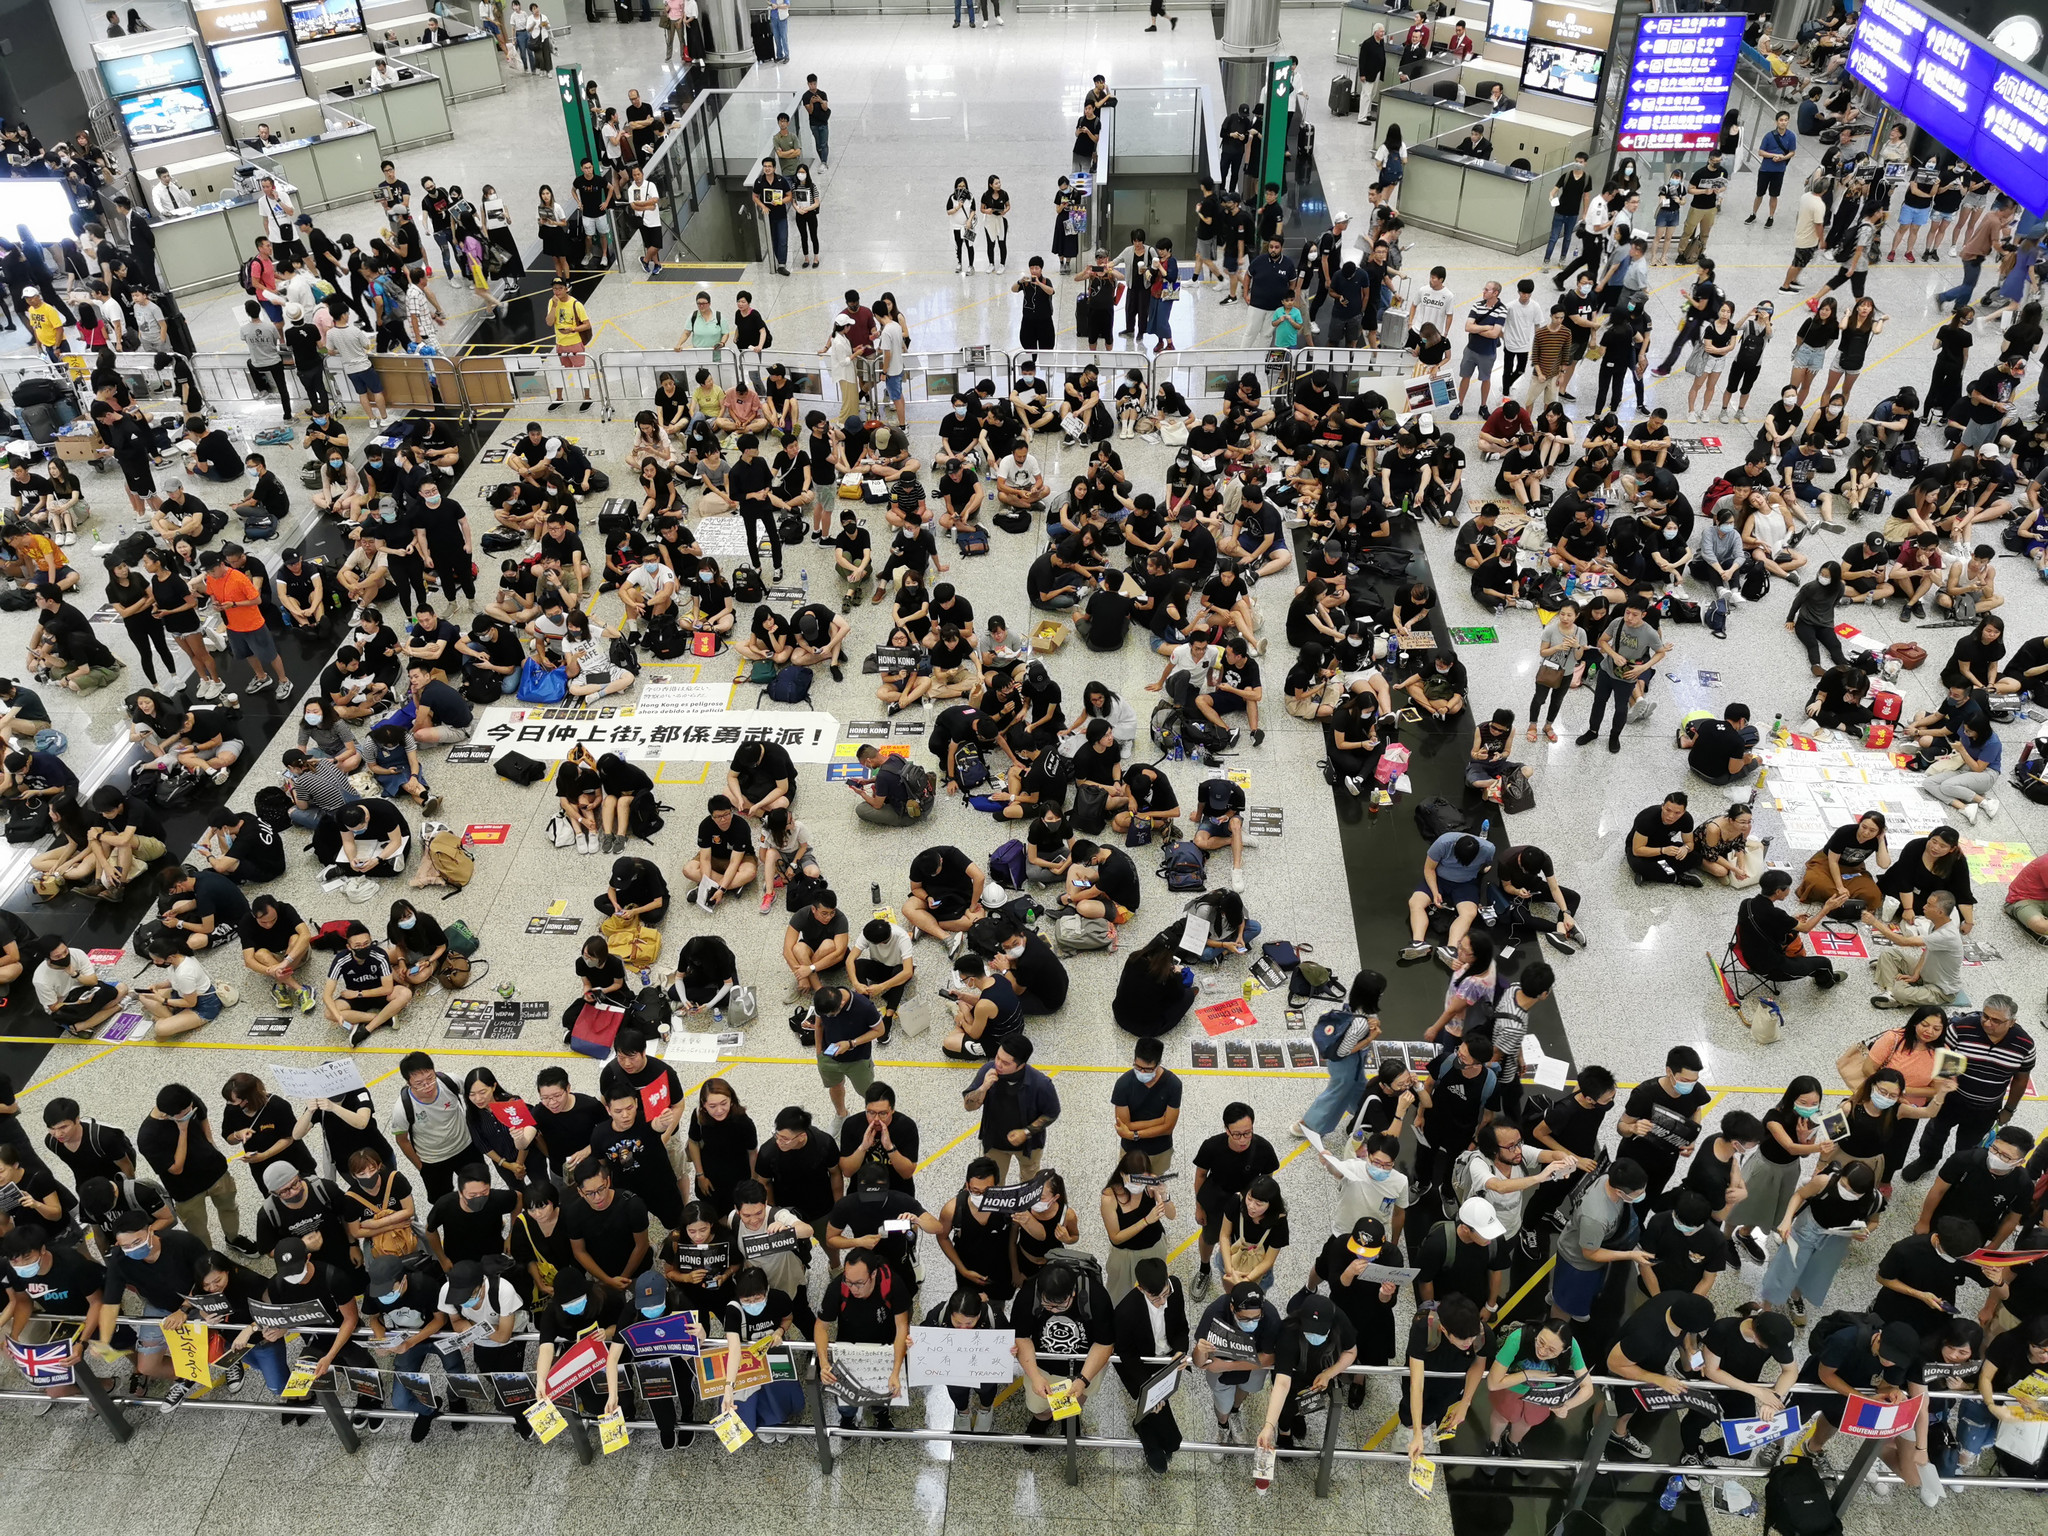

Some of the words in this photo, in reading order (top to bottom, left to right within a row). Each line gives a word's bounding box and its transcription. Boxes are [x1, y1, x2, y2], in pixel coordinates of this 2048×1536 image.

[1422, 296, 1444, 307] Spazio
[1578, 305, 1592, 313] FILA
[579, 649, 599, 664] SAFE
[878, 656, 896, 664] HONG
[898, 657, 915, 666] KONG
[1258, 958, 1270, 972] KONG
[1266, 971, 1282, 985] HONG
[1231, 1006, 1243, 1014] No
[325, 1068, 348, 1080] HIDE
[984, 1197, 1015, 1208] HONG
[1018, 1185, 1043, 1207] KONG
[289, 1218, 313, 1230] adidas
[746, 1242, 770, 1254] HONG
[772, 1238, 795, 1249] KONG
[679, 1254, 701, 1265] HONG
[704, 1254, 726, 1265] KONG
[28, 1283, 48, 1293] JUST
[204, 1302, 228, 1312] KONG
[254, 1315, 288, 1327] HONG
[289, 1312, 325, 1322] KONG
[749, 1320, 774, 1331] FLORIDA
[1208, 1331, 1228, 1348] HONG
[1230, 1342, 1254, 1353] KONG
[682, 1344, 696, 1352] KONG
[577, 1366, 593, 1380] HONG
[591, 1358, 607, 1371] KONG
[1924, 1368, 1950, 1376] HONG
[1953, 1365, 1978, 1376] KONG
[51, 1374, 69, 1382] KONG
[832, 1382, 856, 1400] ONG
[1525, 1395, 1560, 1404] HONG
[1646, 1394, 1681, 1405] HONG
[1684, 1395, 1718, 1414] KONG
[1848, 1425, 1878, 1436] SOUTENIR
[1879, 1427, 1894, 1436] HONG
[1895, 1422, 1909, 1432] KONG
